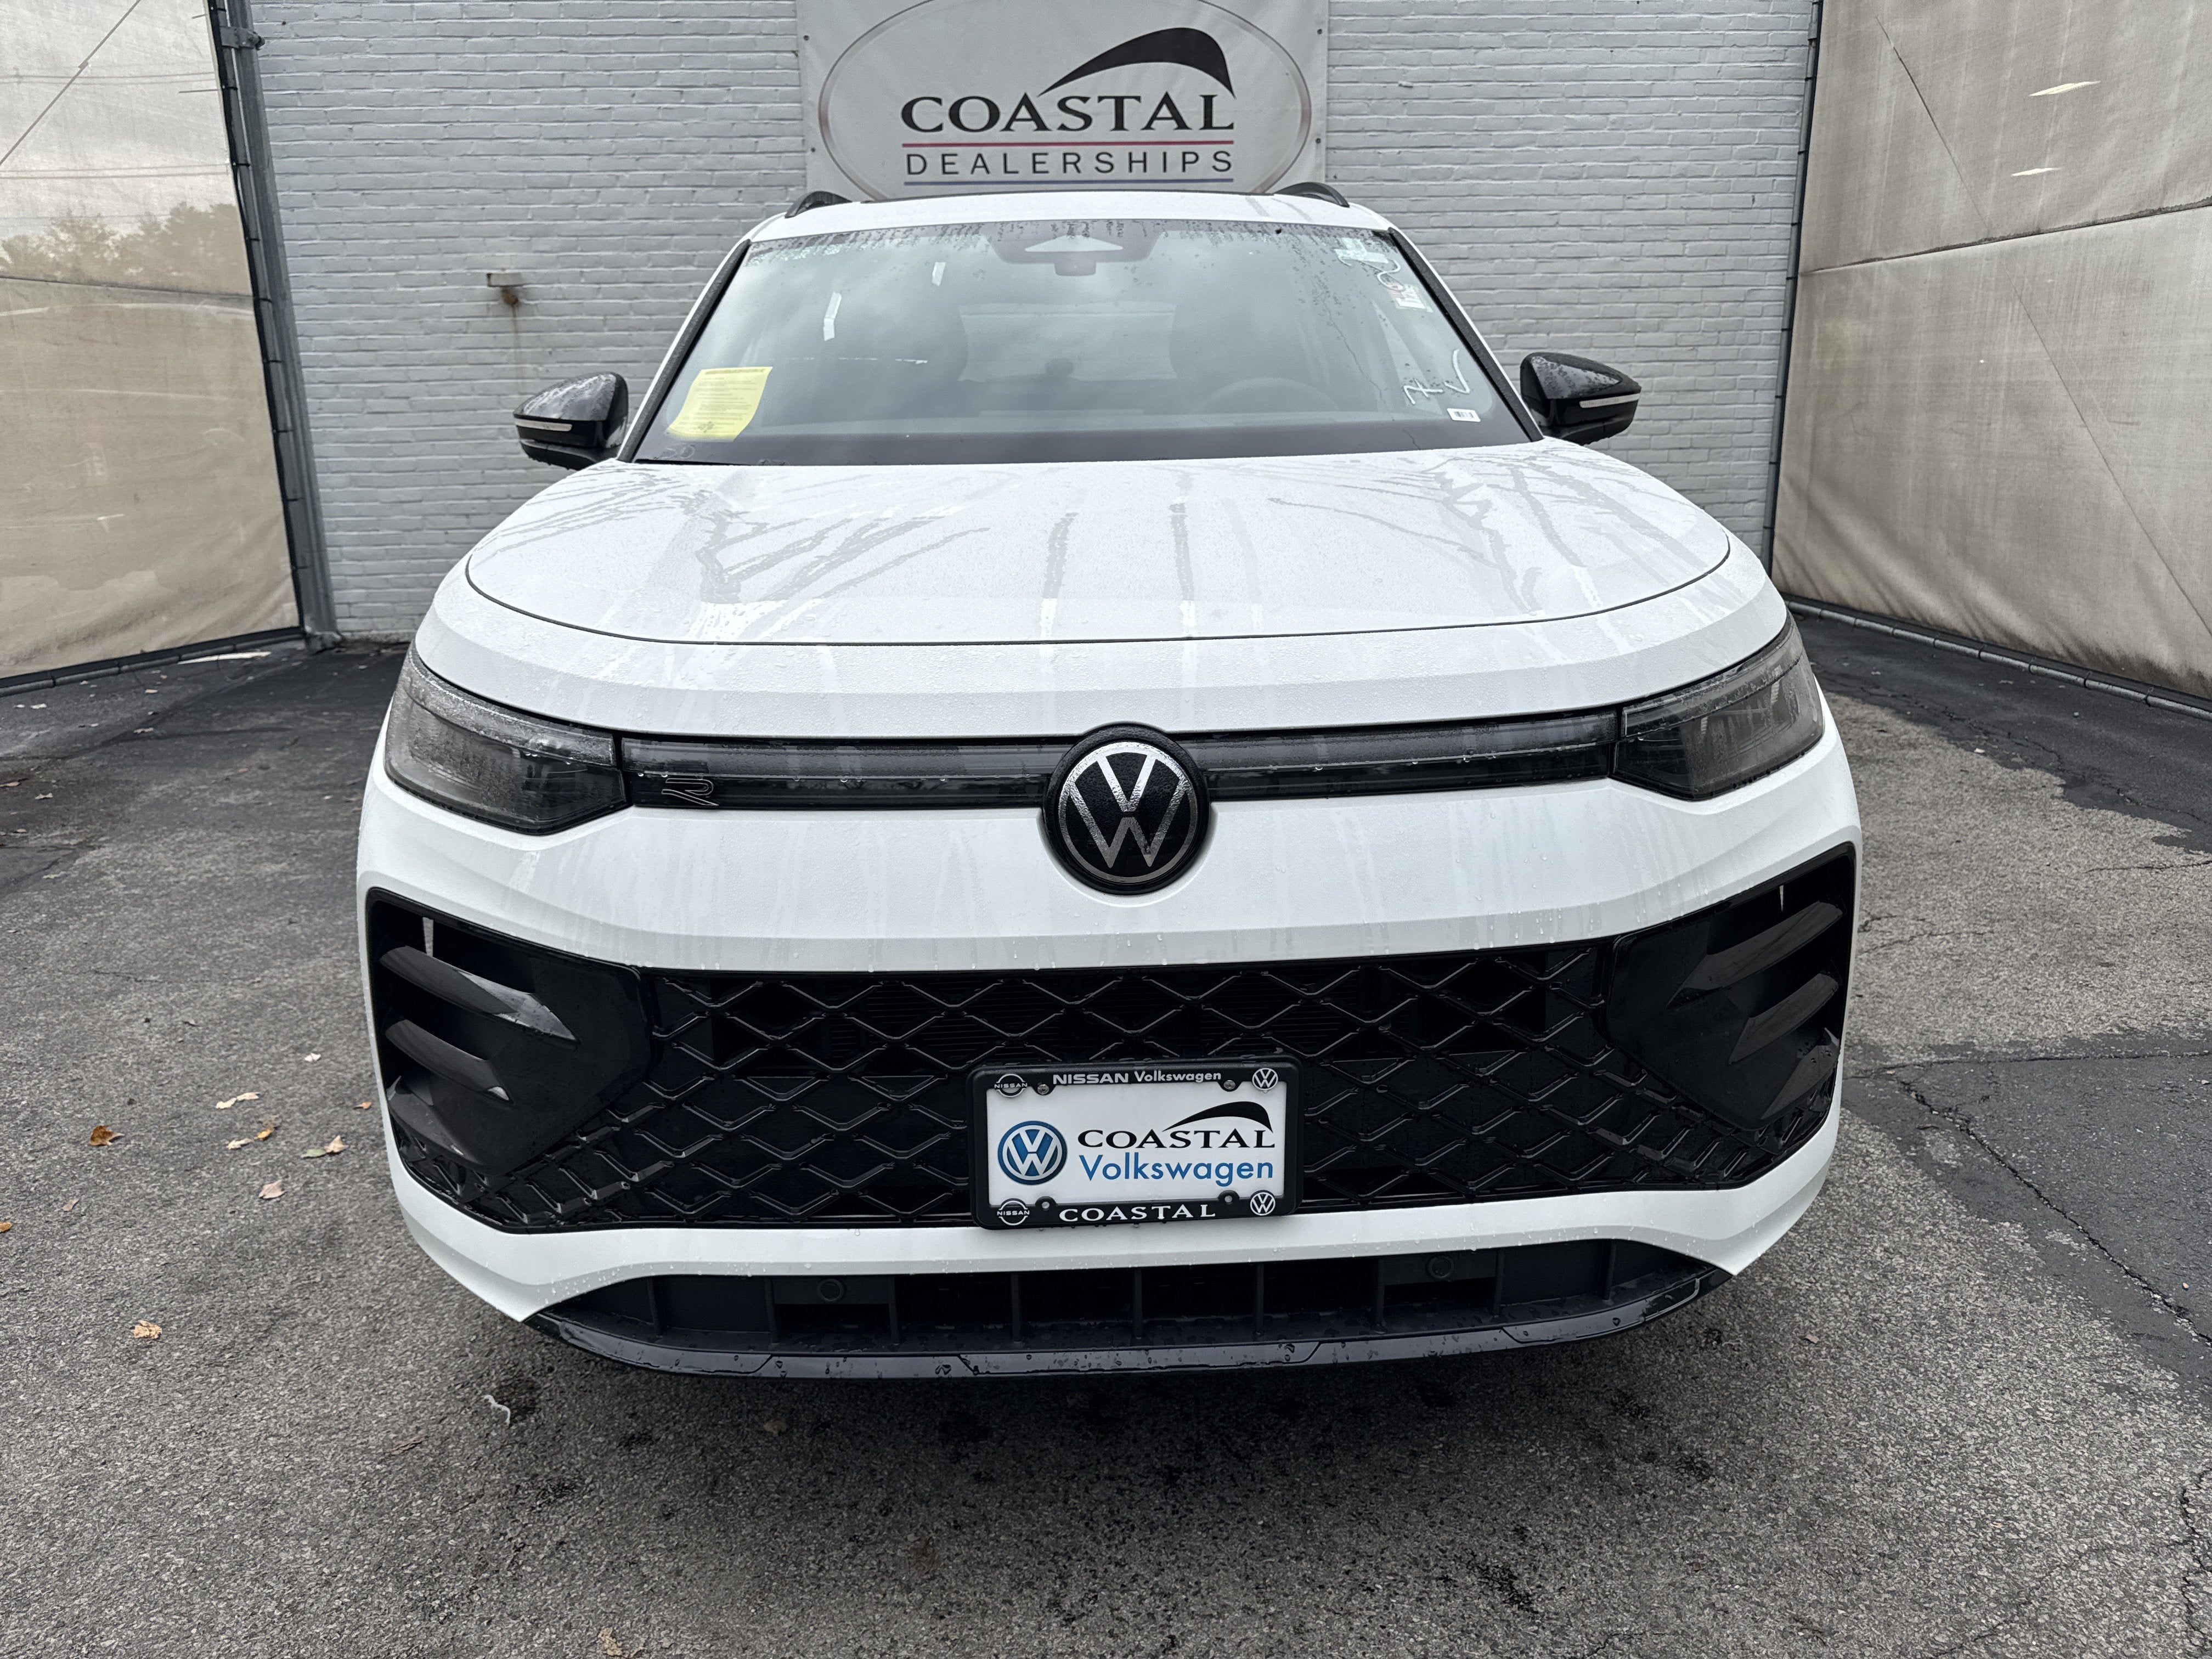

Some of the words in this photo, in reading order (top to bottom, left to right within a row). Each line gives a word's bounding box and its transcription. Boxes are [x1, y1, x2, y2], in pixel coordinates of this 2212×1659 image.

[901, 92, 1234, 132] COASTAL
[906, 151, 1232, 175] DEALERSHIPS
[1052, 1073, 1128, 1085] NISSAN
[1133, 1070, 1222, 1083] Volkswagen
[1077, 1128, 1275, 1149] COASTAL
[1079, 1152, 1273, 1187] Volkswagen
[1059, 1204, 1215, 1222] COASTAL
